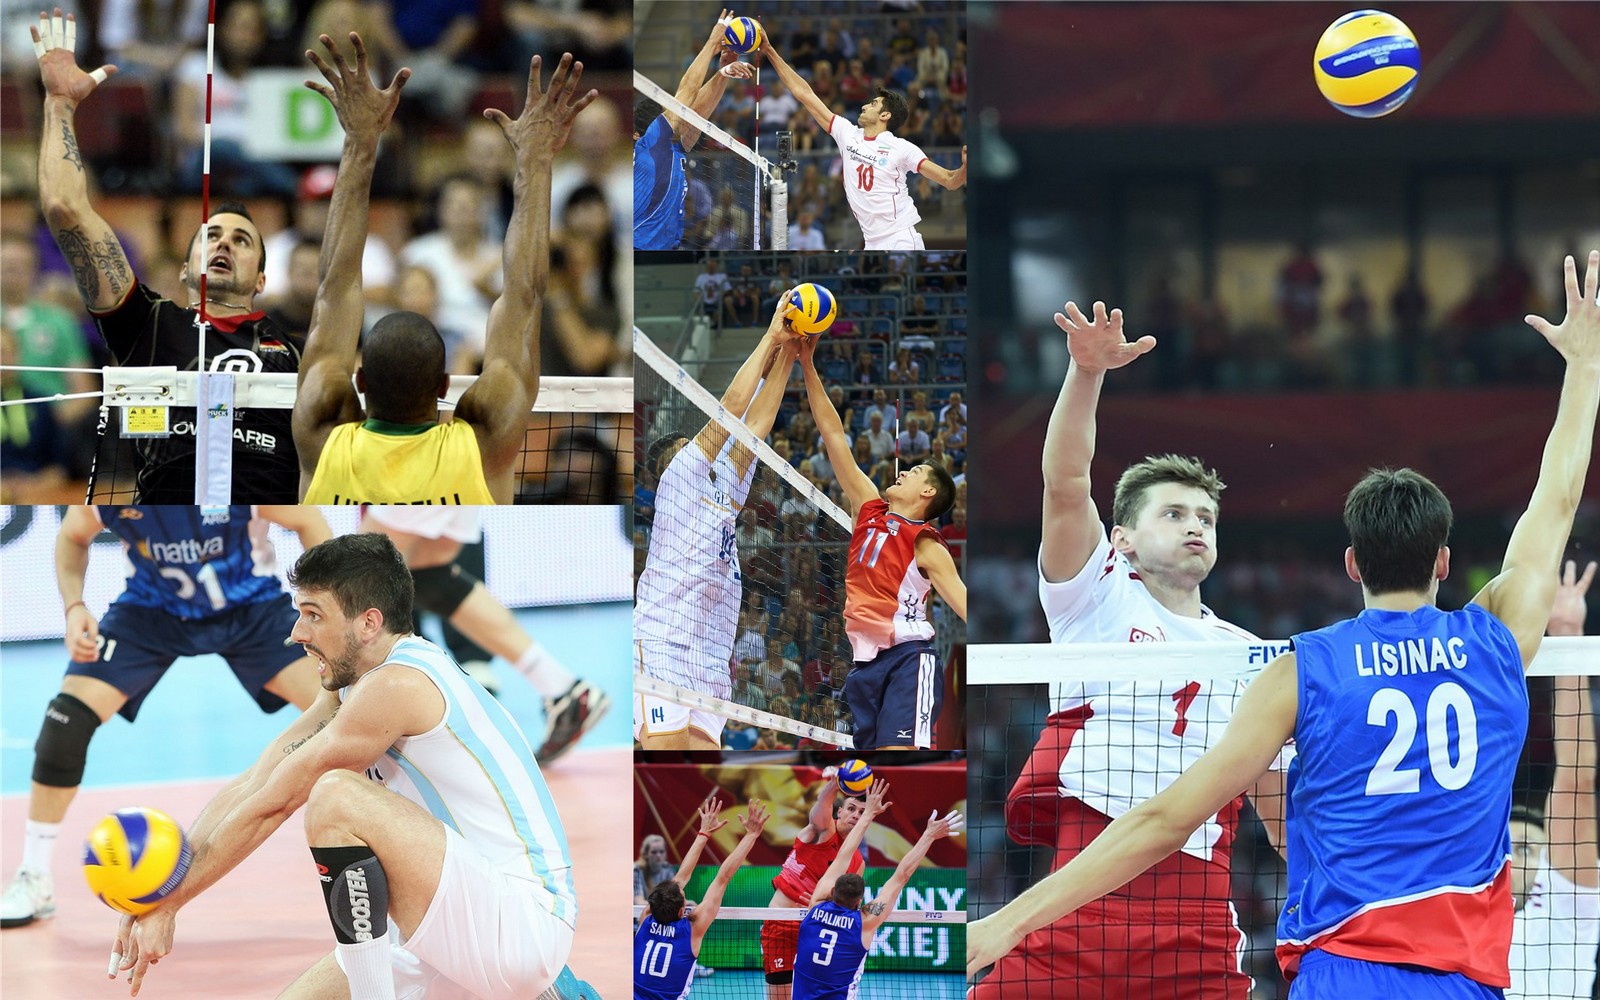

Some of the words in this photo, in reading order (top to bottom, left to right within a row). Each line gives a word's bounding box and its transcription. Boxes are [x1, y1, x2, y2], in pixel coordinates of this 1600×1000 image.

[856, 163, 875, 192] 10
[152, 536, 223, 565] nativa
[857, 527, 890, 570] 11
[1354, 636, 1468, 677] LISINAC
[651, 706, 665, 724] 14
[1172, 680, 1202, 737] 1
[1365, 681, 1479, 797] 20
[650, 922, 676, 938] SAVIN
[811, 907, 855, 930] APALIKOV
[640, 939, 674, 978] 10
[773, 957, 785, 969] 12
[812, 928, 839, 967] 3
